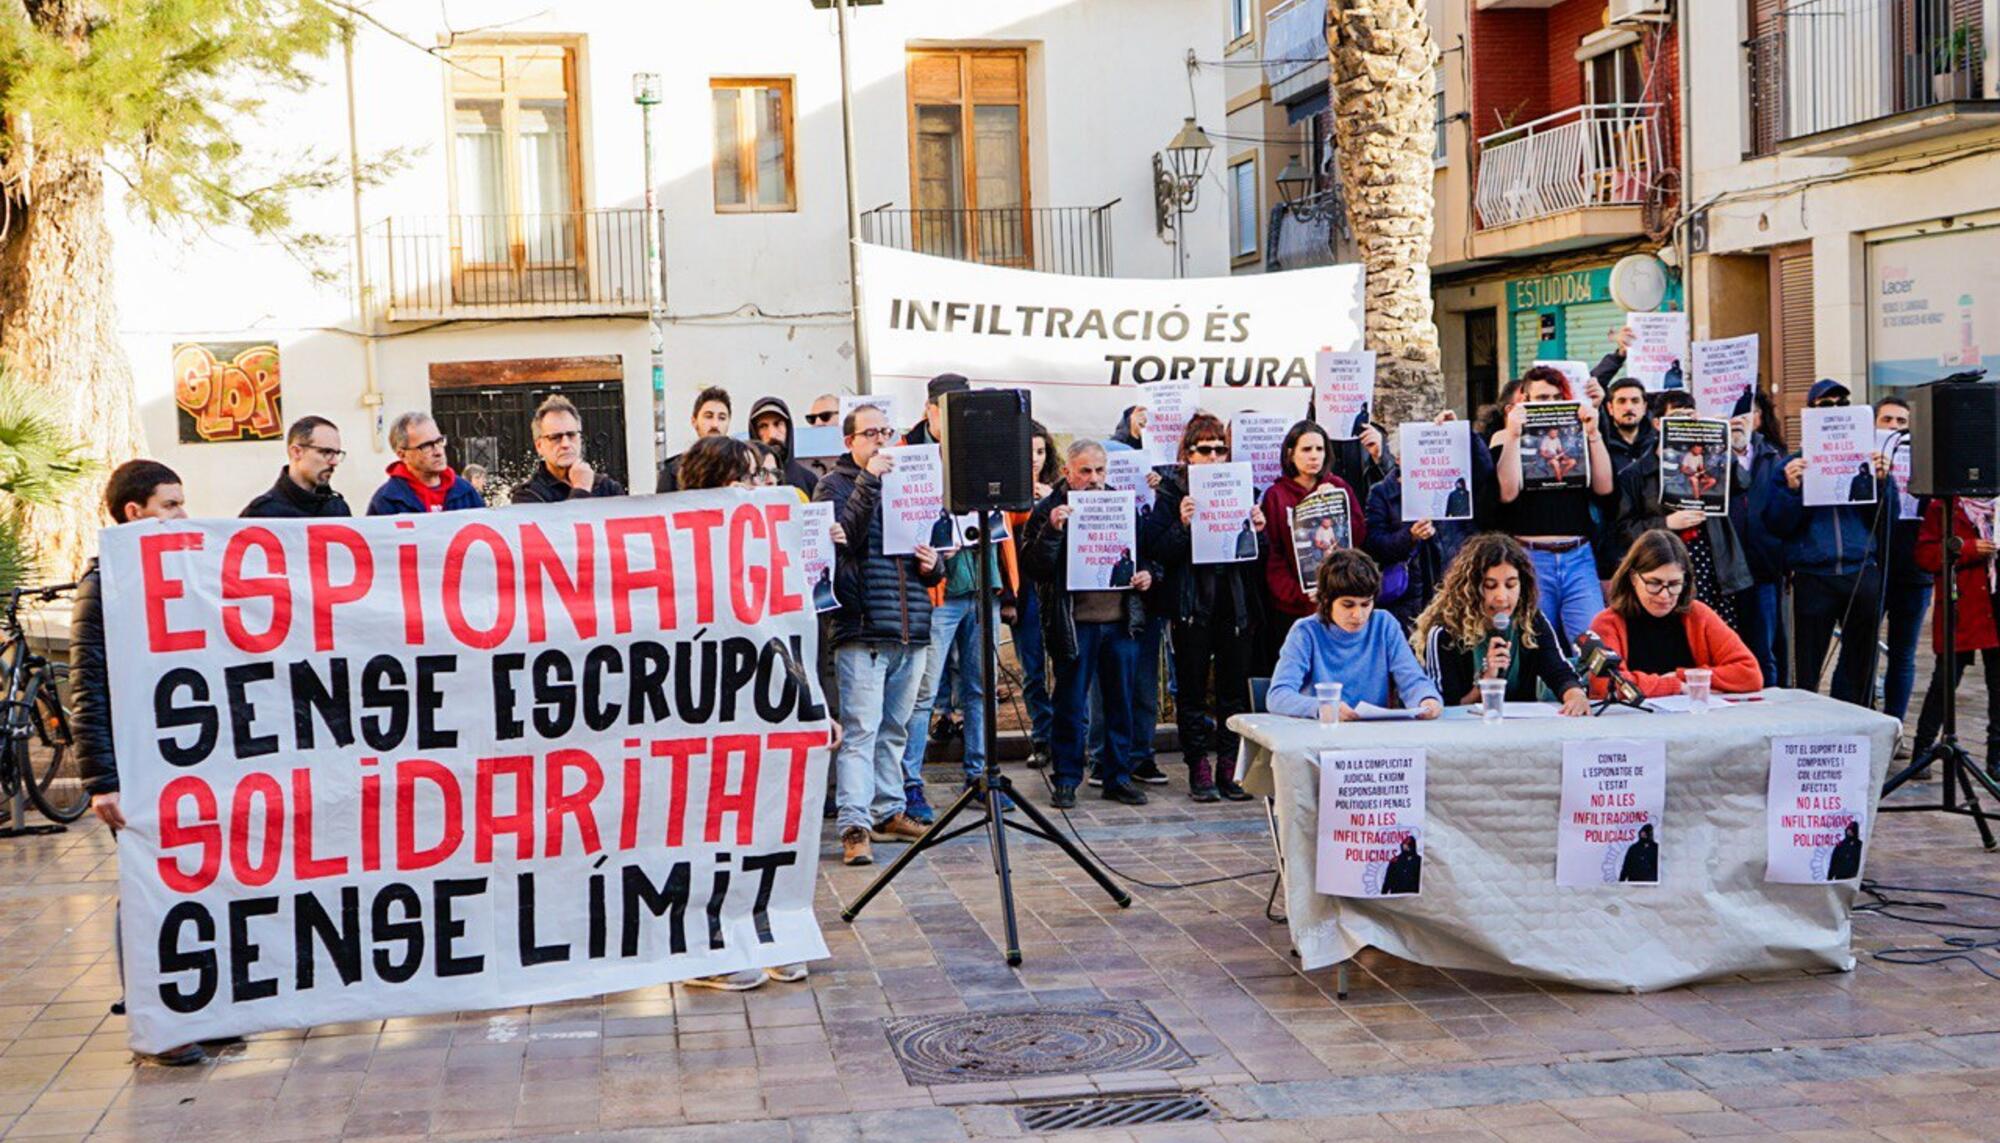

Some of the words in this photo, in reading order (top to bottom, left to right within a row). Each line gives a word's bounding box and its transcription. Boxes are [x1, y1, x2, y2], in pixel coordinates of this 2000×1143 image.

[889, 298, 1190, 343] INFILTRACIÓ
[1203, 304, 1251, 344] ÉS
[1104, 354, 1314, 388] TORTURA
[903, 484, 912, 494] NO
[920, 482, 933, 492] LES
[140, 502, 804, 654] ESPIONATGE
[153, 653, 459, 768] SENSE
[491, 627, 827, 742] ESCRÚPOL
[1785, 744, 1798, 755] TOT
[1800, 744, 1807, 754] EL
[1810, 744, 1836, 755] SUPORT
[1844, 744, 1857, 754] LES
[1335, 761, 1345, 770] NO
[1347, 761, 1352, 769] A
[1354, 760, 1362, 769] LA
[1365, 758, 1413, 769] COMPLICITAT
[1598, 754, 1627, 763] CONTRA
[1797, 758, 1840, 767] COMPANYES
[1379, 772, 1404, 783] EXIGIM
[1582, 767, 1632, 778] L'ESPIONATGE
[1634, 766, 1643, 776] DE
[1338, 786, 1409, 797] RESPONSABILITATS
[1599, 780, 1628, 790] L'ESTAT
[1801, 783, 1837, 793] AFECTATS
[1384, 798, 1412, 808] PENALS
[1591, 794, 1605, 807] NO
[1608, 794, 1614, 806] A
[1617, 794, 1635, 806] LES
[1797, 797, 1810, 809] NO
[1814, 797, 1820, 809] A
[1823, 796, 1841, 809] LES
[156, 731, 829, 894] SOLIDARITAT
[1350, 813, 1365, 826] NO
[1368, 814, 1375, 826] A
[1378, 812, 1396, 825] LES
[1573, 811, 1648, 825] INFILTRACIONS
[1782, 815, 1855, 828] INFILTRACIONS
[1334, 830, 1410, 844] INFILTRACIONS
[1585, 829, 1635, 843] POLICIALS
[1793, 834, 1843, 847] POLICIALS
[1346, 848, 1399, 862] POLICIALS
[157, 876, 488, 1014] SENSE
[517, 851, 798, 968] LÍMIT
